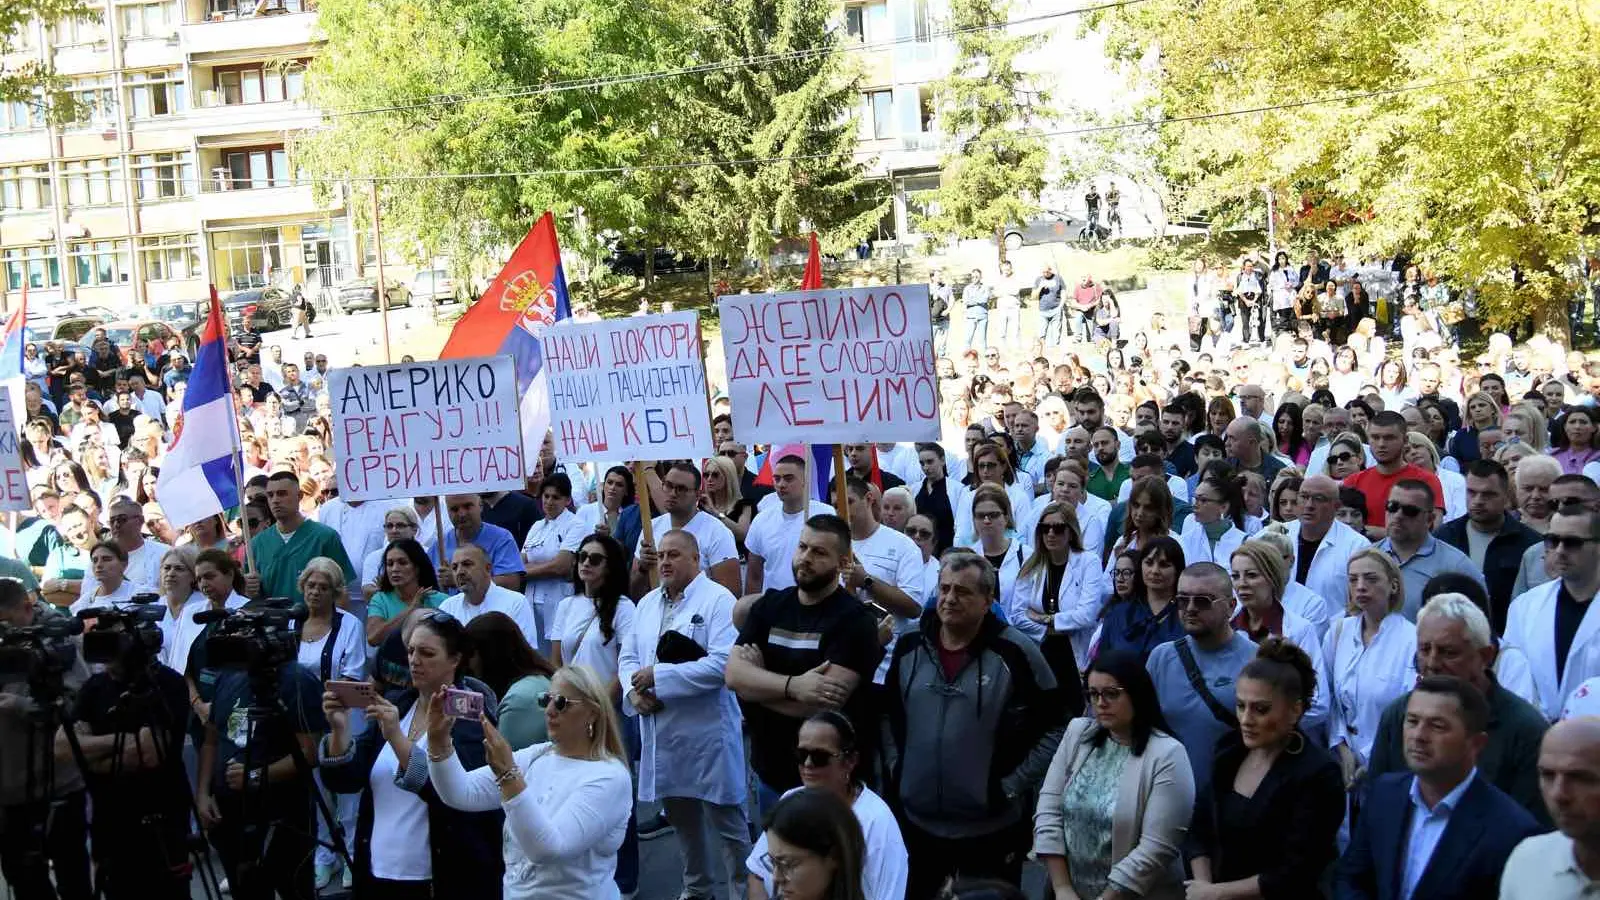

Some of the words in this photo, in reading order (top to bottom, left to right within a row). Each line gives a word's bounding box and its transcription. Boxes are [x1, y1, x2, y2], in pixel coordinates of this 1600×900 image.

[731, 292, 907, 345] ЖЕЛИМО
[544, 333, 601, 373] НАШИ
[610, 323, 702, 368] ДОКТОРИ
[730, 347, 775, 382] ДА
[780, 344, 813, 377] СЕ
[818, 339, 937, 378] СЛОБОДНО
[340, 363, 496, 414] АМЕРИКО
[551, 373, 601, 410] НАШИ
[608, 363, 705, 405] ПАЦИЈЕНТИ
[755, 376, 936, 427] ЛЕЧИМО
[343, 406, 464, 456] РЕАГУЈ
[475, 401, 502, 435] !!!
[560, 417, 608, 455] НАШ
[344, 452, 421, 492] СРБИ
[430, 445, 521, 486] НЕСТАЈУ
